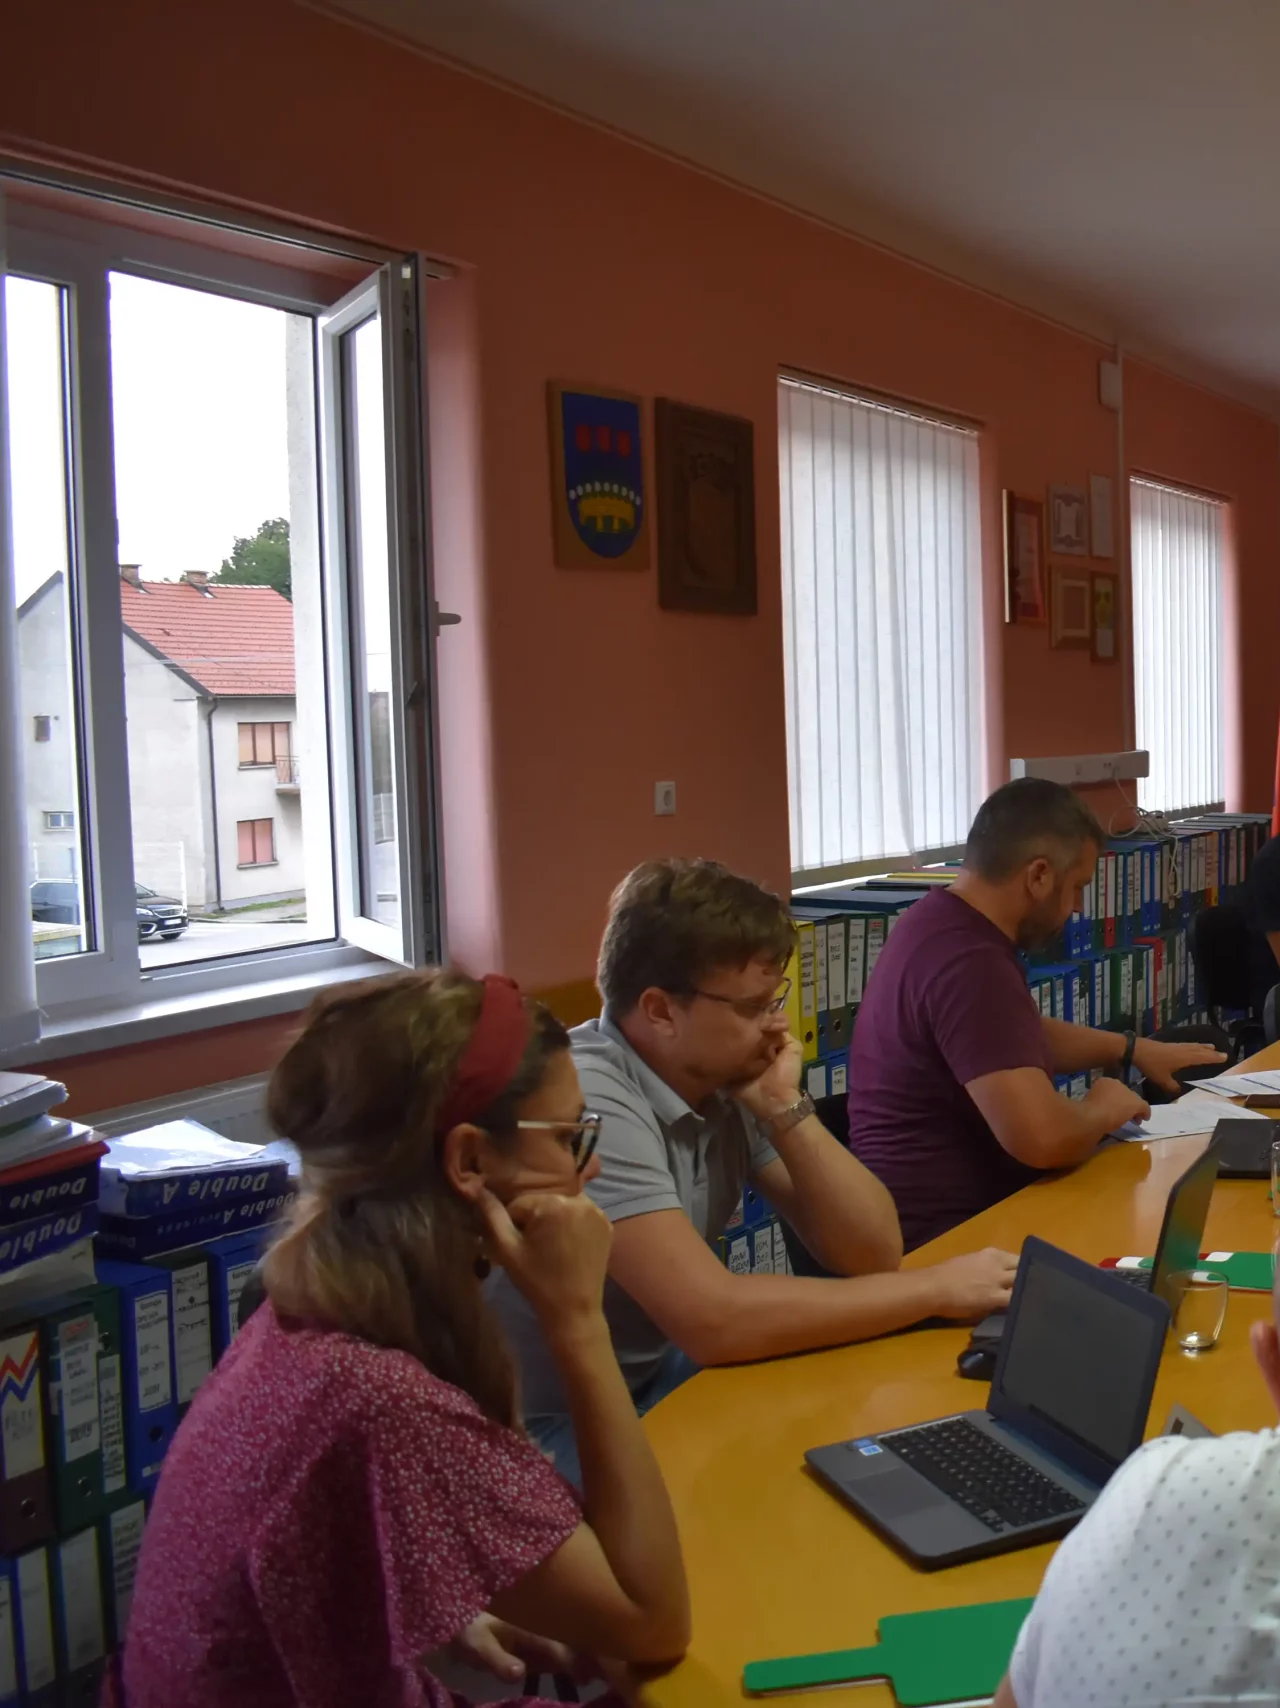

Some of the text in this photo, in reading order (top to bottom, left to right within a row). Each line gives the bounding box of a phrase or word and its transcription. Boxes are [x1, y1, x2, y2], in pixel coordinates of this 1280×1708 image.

[9, 1177, 87, 1208] Double
[163, 1172, 270, 1205] Double A
[240, 1192, 295, 1218] Double
[0, 1213, 81, 1258] Double
